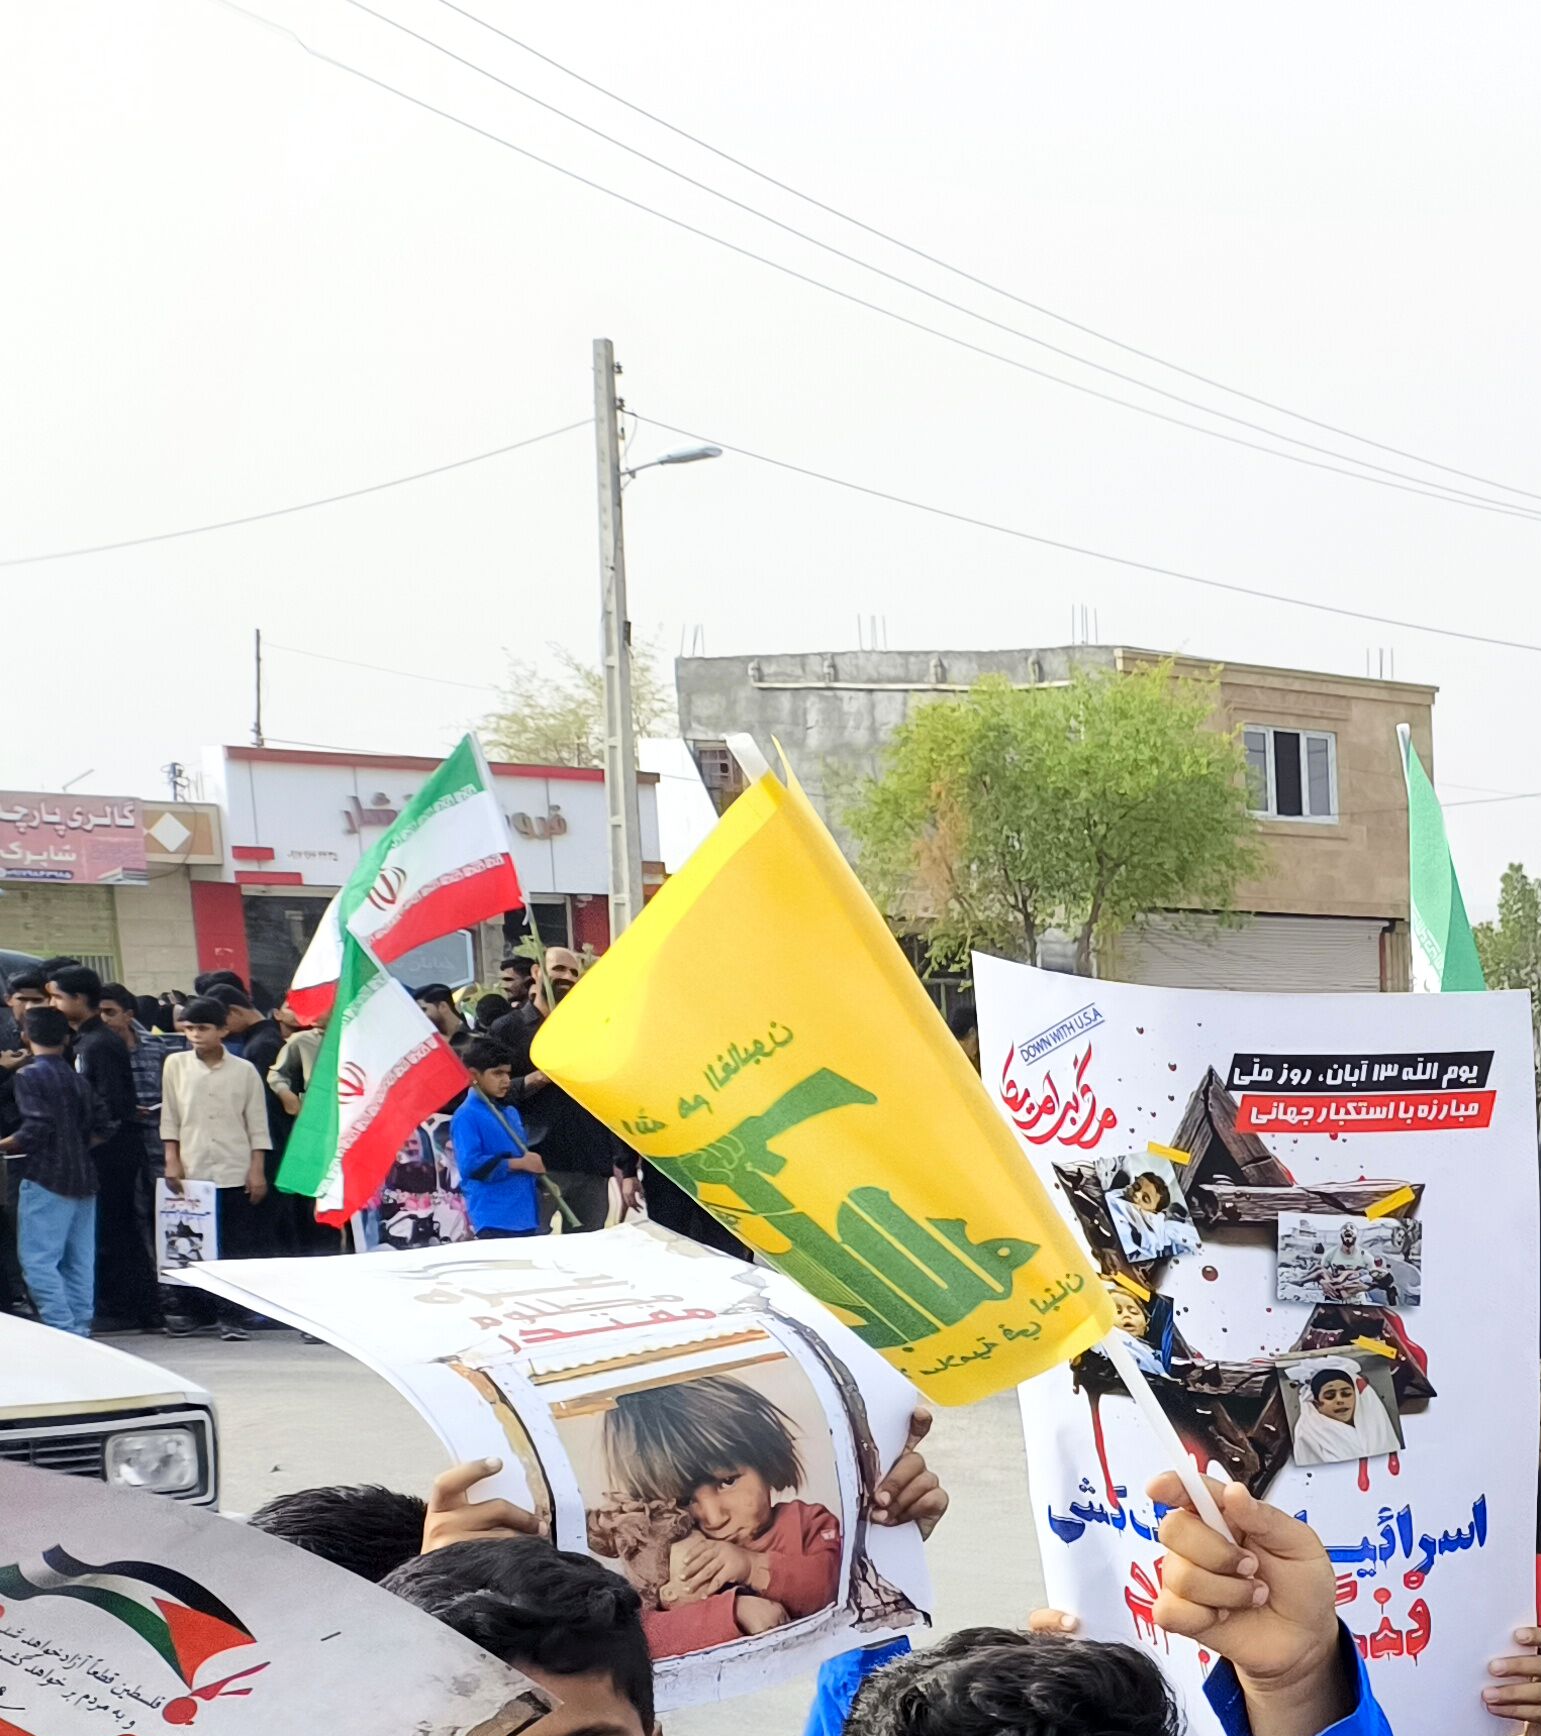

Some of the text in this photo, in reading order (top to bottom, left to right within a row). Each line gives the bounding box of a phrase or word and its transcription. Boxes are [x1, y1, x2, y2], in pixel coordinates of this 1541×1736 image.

[0, 801, 136, 838] گالری پارچ
[1019, 1007, 1104, 1063] DOWN WITH U.S.A
[1276, 1062, 1313, 1085] روز
[1371, 1062, 1399, 1082] ۱۳
[1402, 1057, 1439, 1082] الله
[1441, 1063, 1479, 1089] یوم
[1250, 1100, 1480, 1126] مبارزه با استکبار جهانی
[498, 1304, 718, 1354] مقتدر
[110, 1682, 166, 1710] فلسطین
